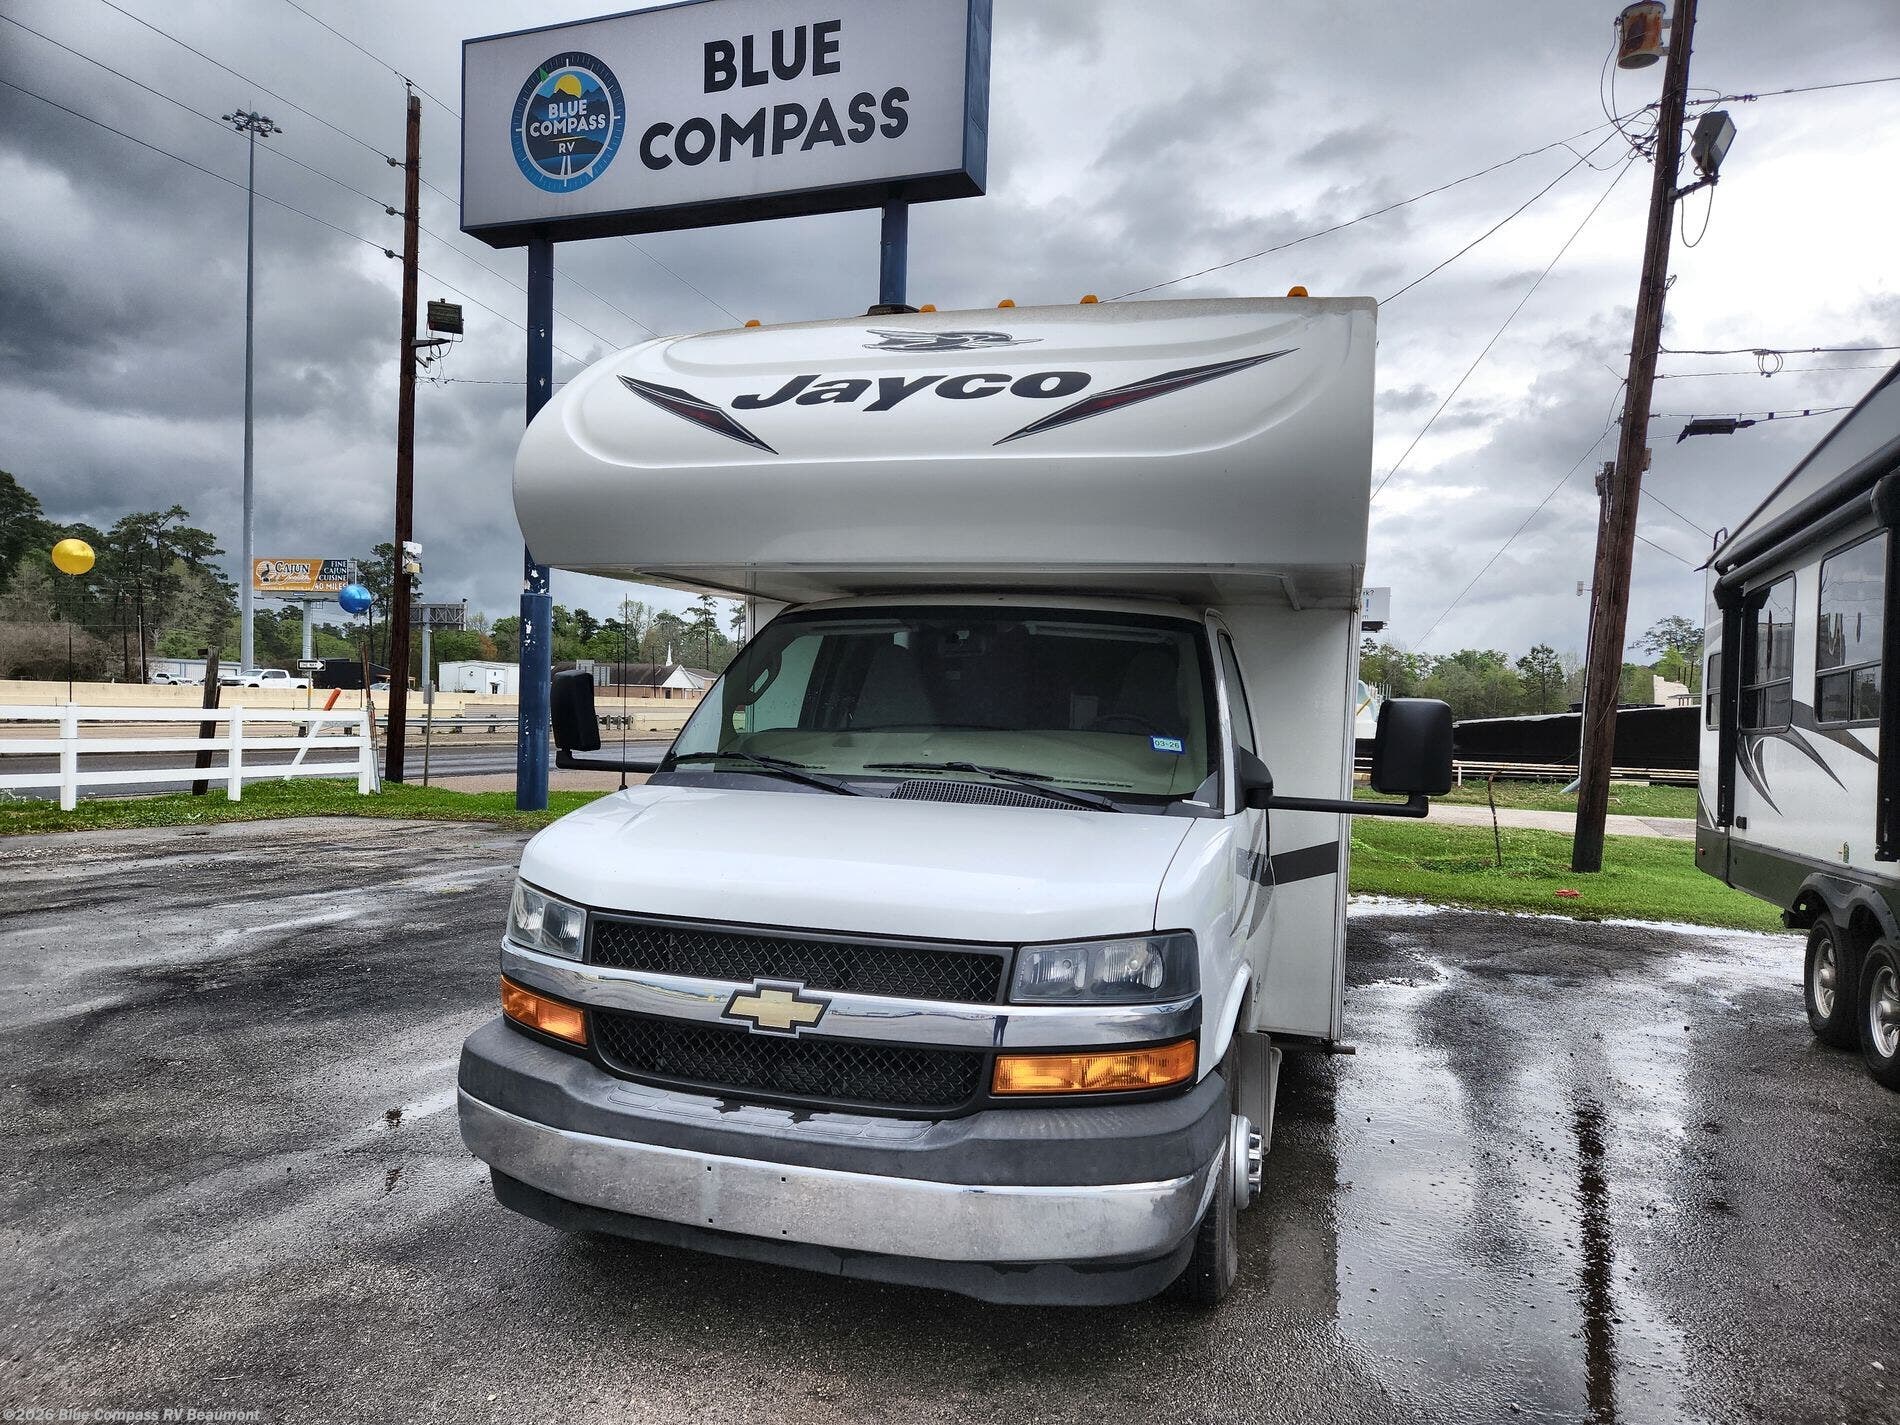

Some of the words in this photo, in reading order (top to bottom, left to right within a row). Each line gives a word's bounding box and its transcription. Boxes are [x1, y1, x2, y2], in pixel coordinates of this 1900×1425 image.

[704, 19, 841, 94] BLUE
[548, 99, 588, 119] BLUE
[529, 113, 606, 137] COMPASS
[639, 86, 910, 170] COMPASS
[558, 141, 576, 154] RV
[731, 371, 1092, 412] Jayco
[326, 582, 347, 591] MILES
